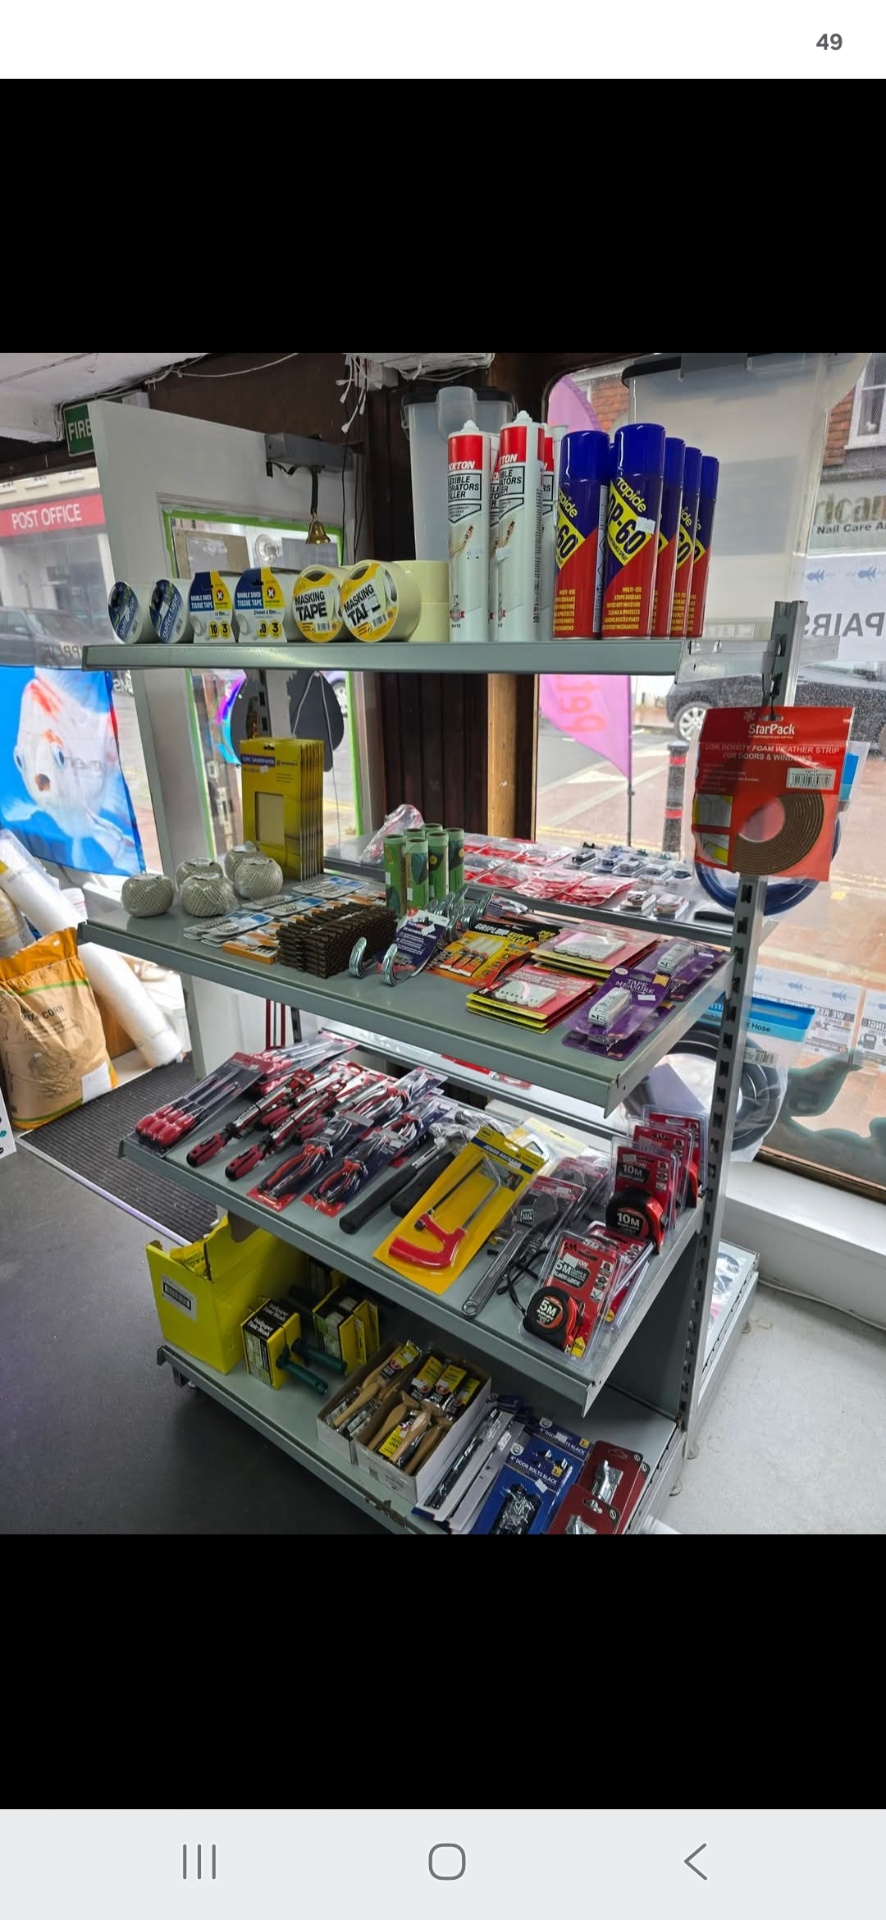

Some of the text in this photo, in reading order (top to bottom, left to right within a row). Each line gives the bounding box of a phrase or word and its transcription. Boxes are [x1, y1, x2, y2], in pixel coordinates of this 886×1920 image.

[616, 477, 647, 513] rapide
[11, 504, 82, 530] POST OFFICE
[817, 525, 840, 535] Nail
[843, 523, 872, 533] Care
[295, 590, 325, 606] MASKING
[344, 584, 375, 613] MASKING
[295, 602, 328, 621] TAPE
[347, 603, 381, 627] TA
[222, 624, 228, 634] 3
[272, 622, 279, 633] 3
[748, 723, 795, 735] StarPack
[775, 745, 813, 754] WEATHER
[615, 980, 655, 994] MEASURE
[626, 978, 648, 987] TAPE
[41, 1005, 65, 1020] CORN
[751, 1023, 772, 1033] Hose
[622, 1164, 643, 1177] 10M
[617, 1212, 640, 1227] 10M
[556, 1260, 571, 1275] 5M
[540, 1299, 558, 1317] 5M
[515, 1457, 529, 1470] DOOR
[528, 1465, 543, 1477] BOLTS
[542, 1472, 557, 1485] BLACK
